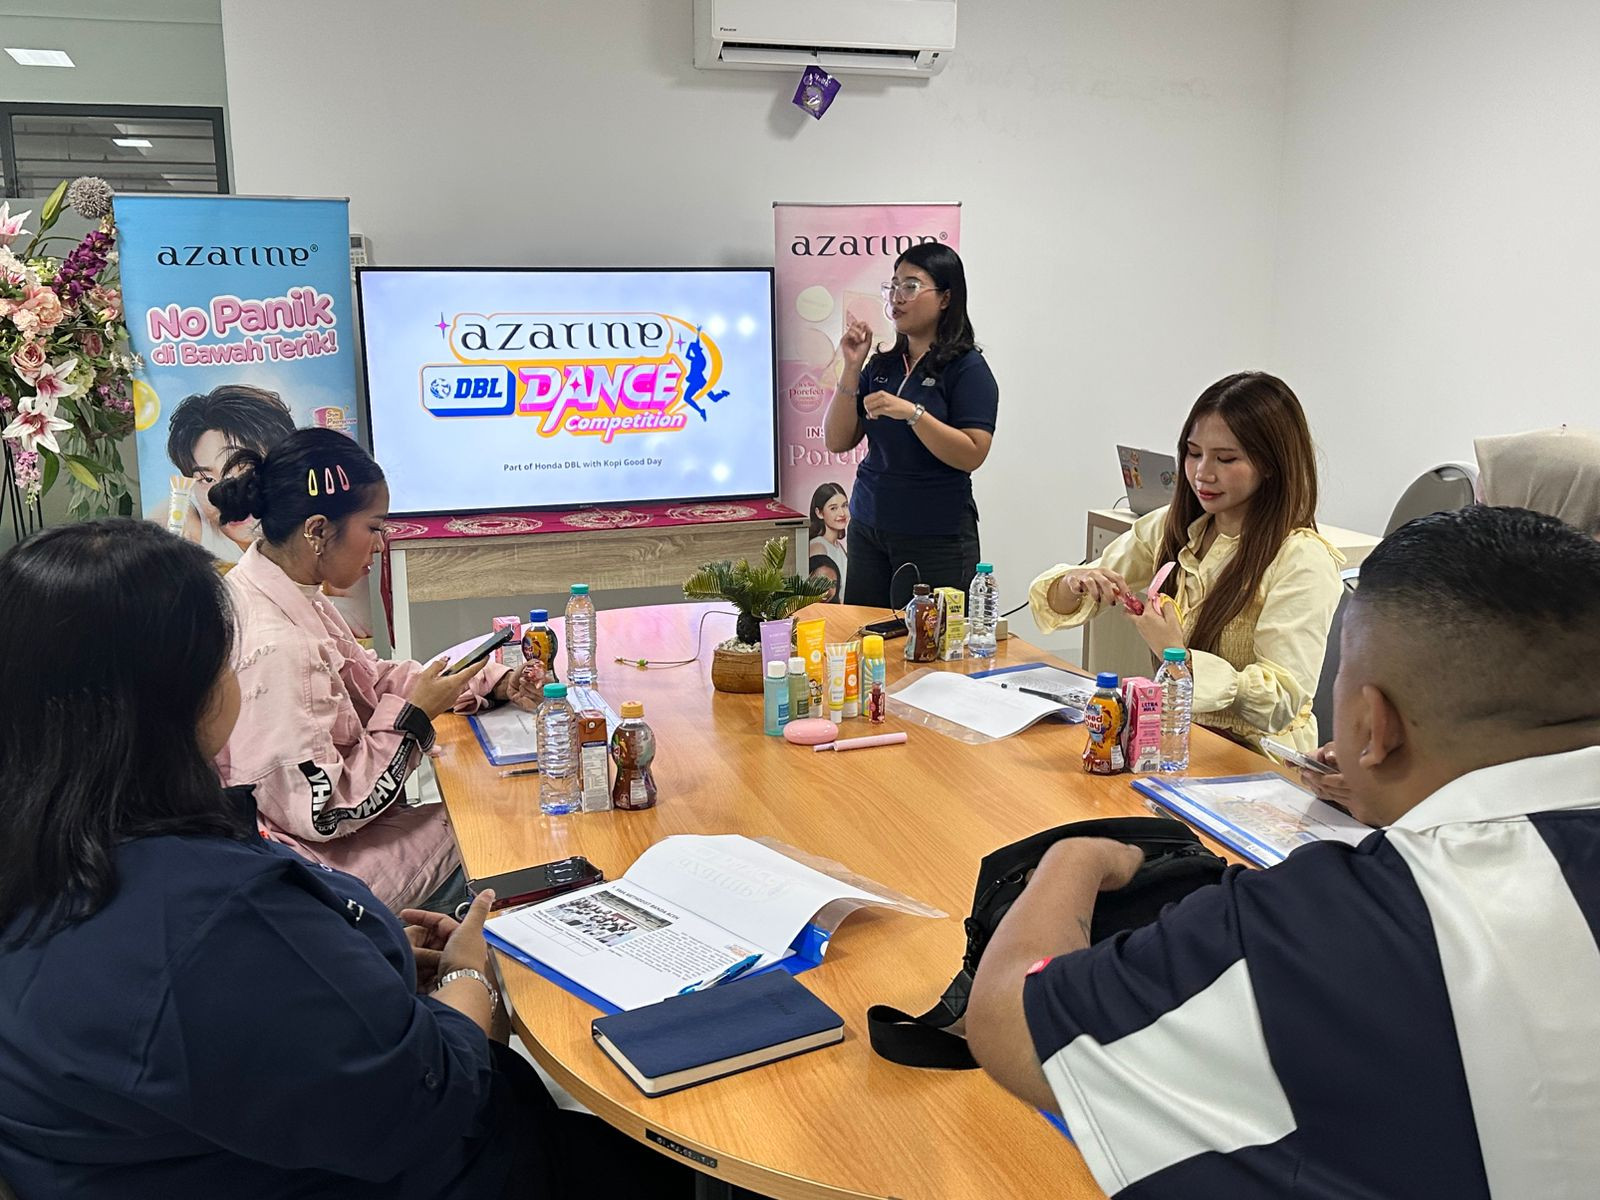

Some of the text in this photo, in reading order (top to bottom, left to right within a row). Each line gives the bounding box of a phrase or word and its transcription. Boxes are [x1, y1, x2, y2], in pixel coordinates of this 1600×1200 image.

[150, 288, 334, 340] No Panik
[153, 331, 337, 365] di Bawah Terik!
[461, 321, 663, 351] azarine
[454, 362, 683, 430] DBL DANCE
[565, 412, 685, 441] Competition
[503, 457, 663, 472] Part of Honda DBL with Kopi Good Day
